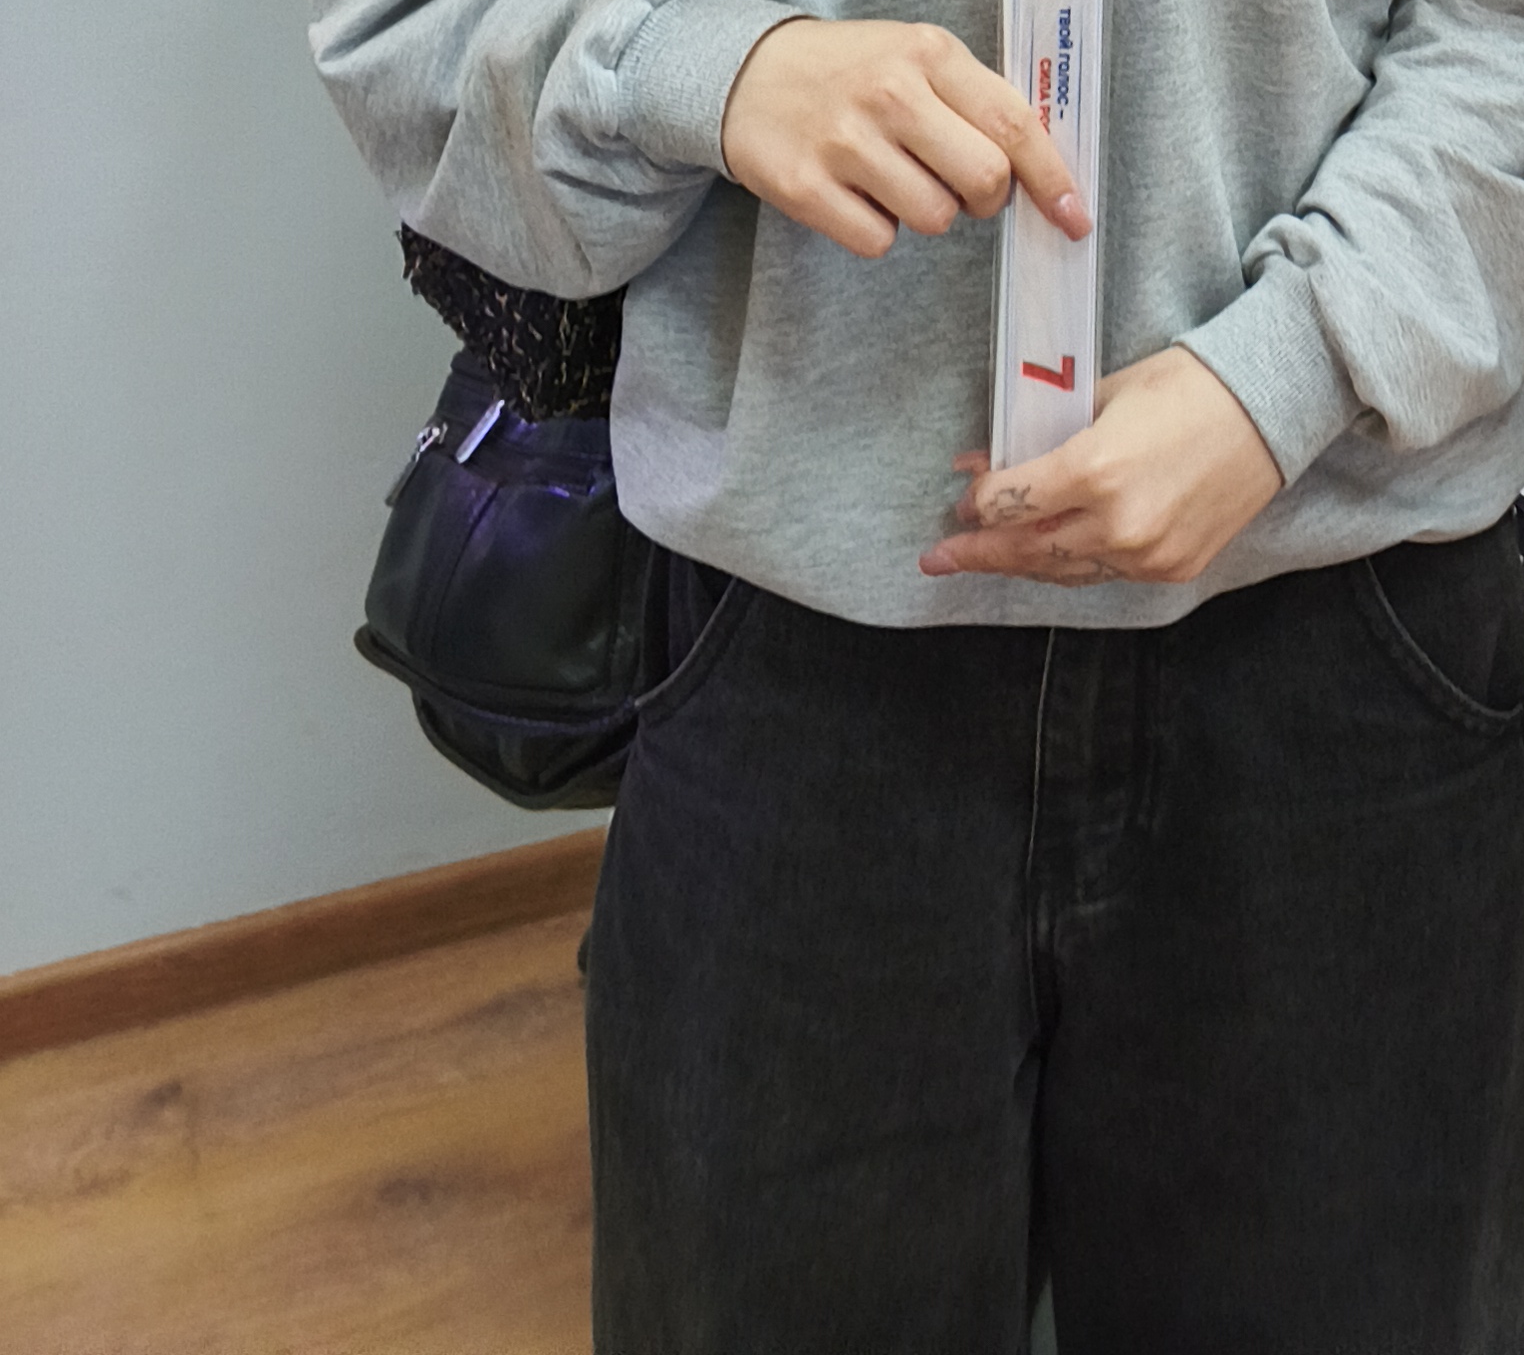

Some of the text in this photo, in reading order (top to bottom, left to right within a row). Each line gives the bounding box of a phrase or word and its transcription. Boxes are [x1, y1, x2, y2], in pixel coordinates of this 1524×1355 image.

[1057, 8, 1073, 106] ТВОЙ ГОЛОС
[1039, 58, 1052, 101] СИЛА
[1021, 355, 1075, 392] 7
